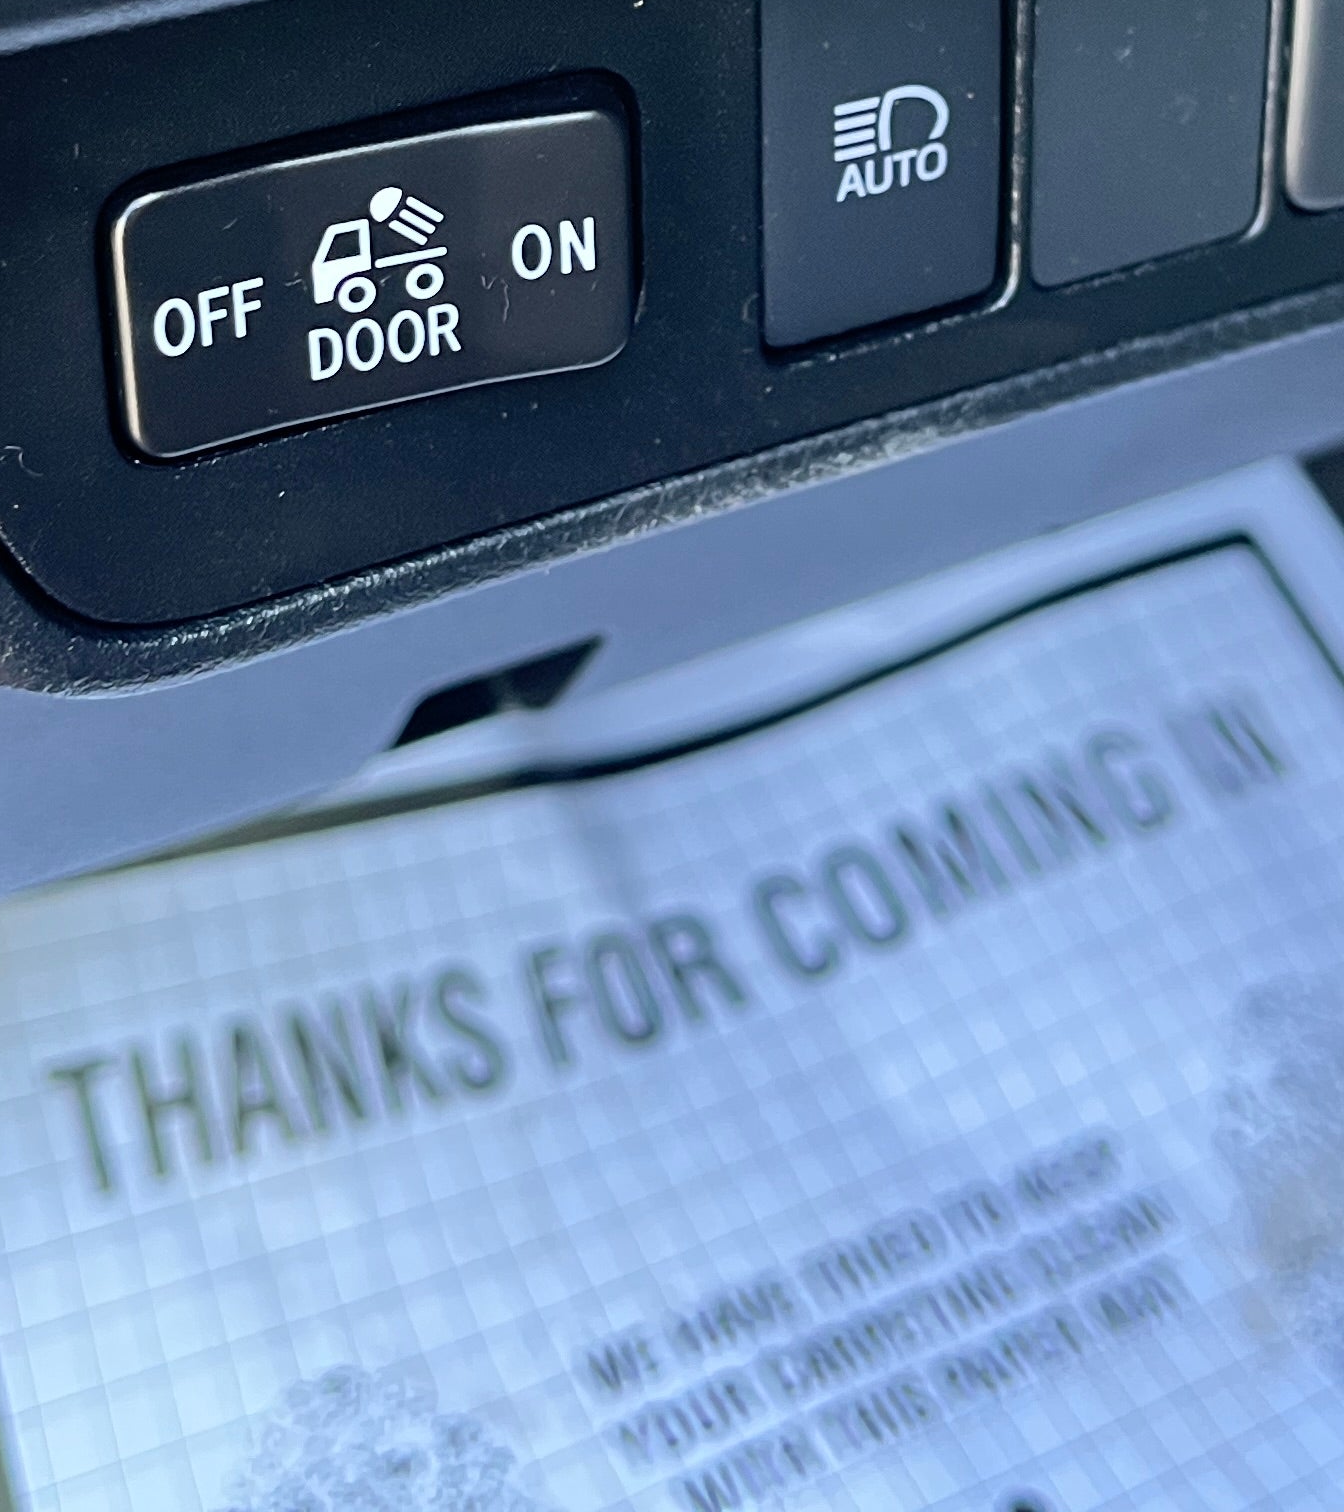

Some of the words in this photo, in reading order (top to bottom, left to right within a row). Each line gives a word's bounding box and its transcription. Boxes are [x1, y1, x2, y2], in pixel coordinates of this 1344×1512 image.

[835, 141, 949, 203] AUTO
[511, 216, 597, 281] ON
[153, 277, 265, 358] OFF
[308, 303, 462, 382] DOOR
[46, 958, 508, 1194] THANKS
[524, 914, 746, 1072] FOR
[752, 724, 1179, 980] COMING
